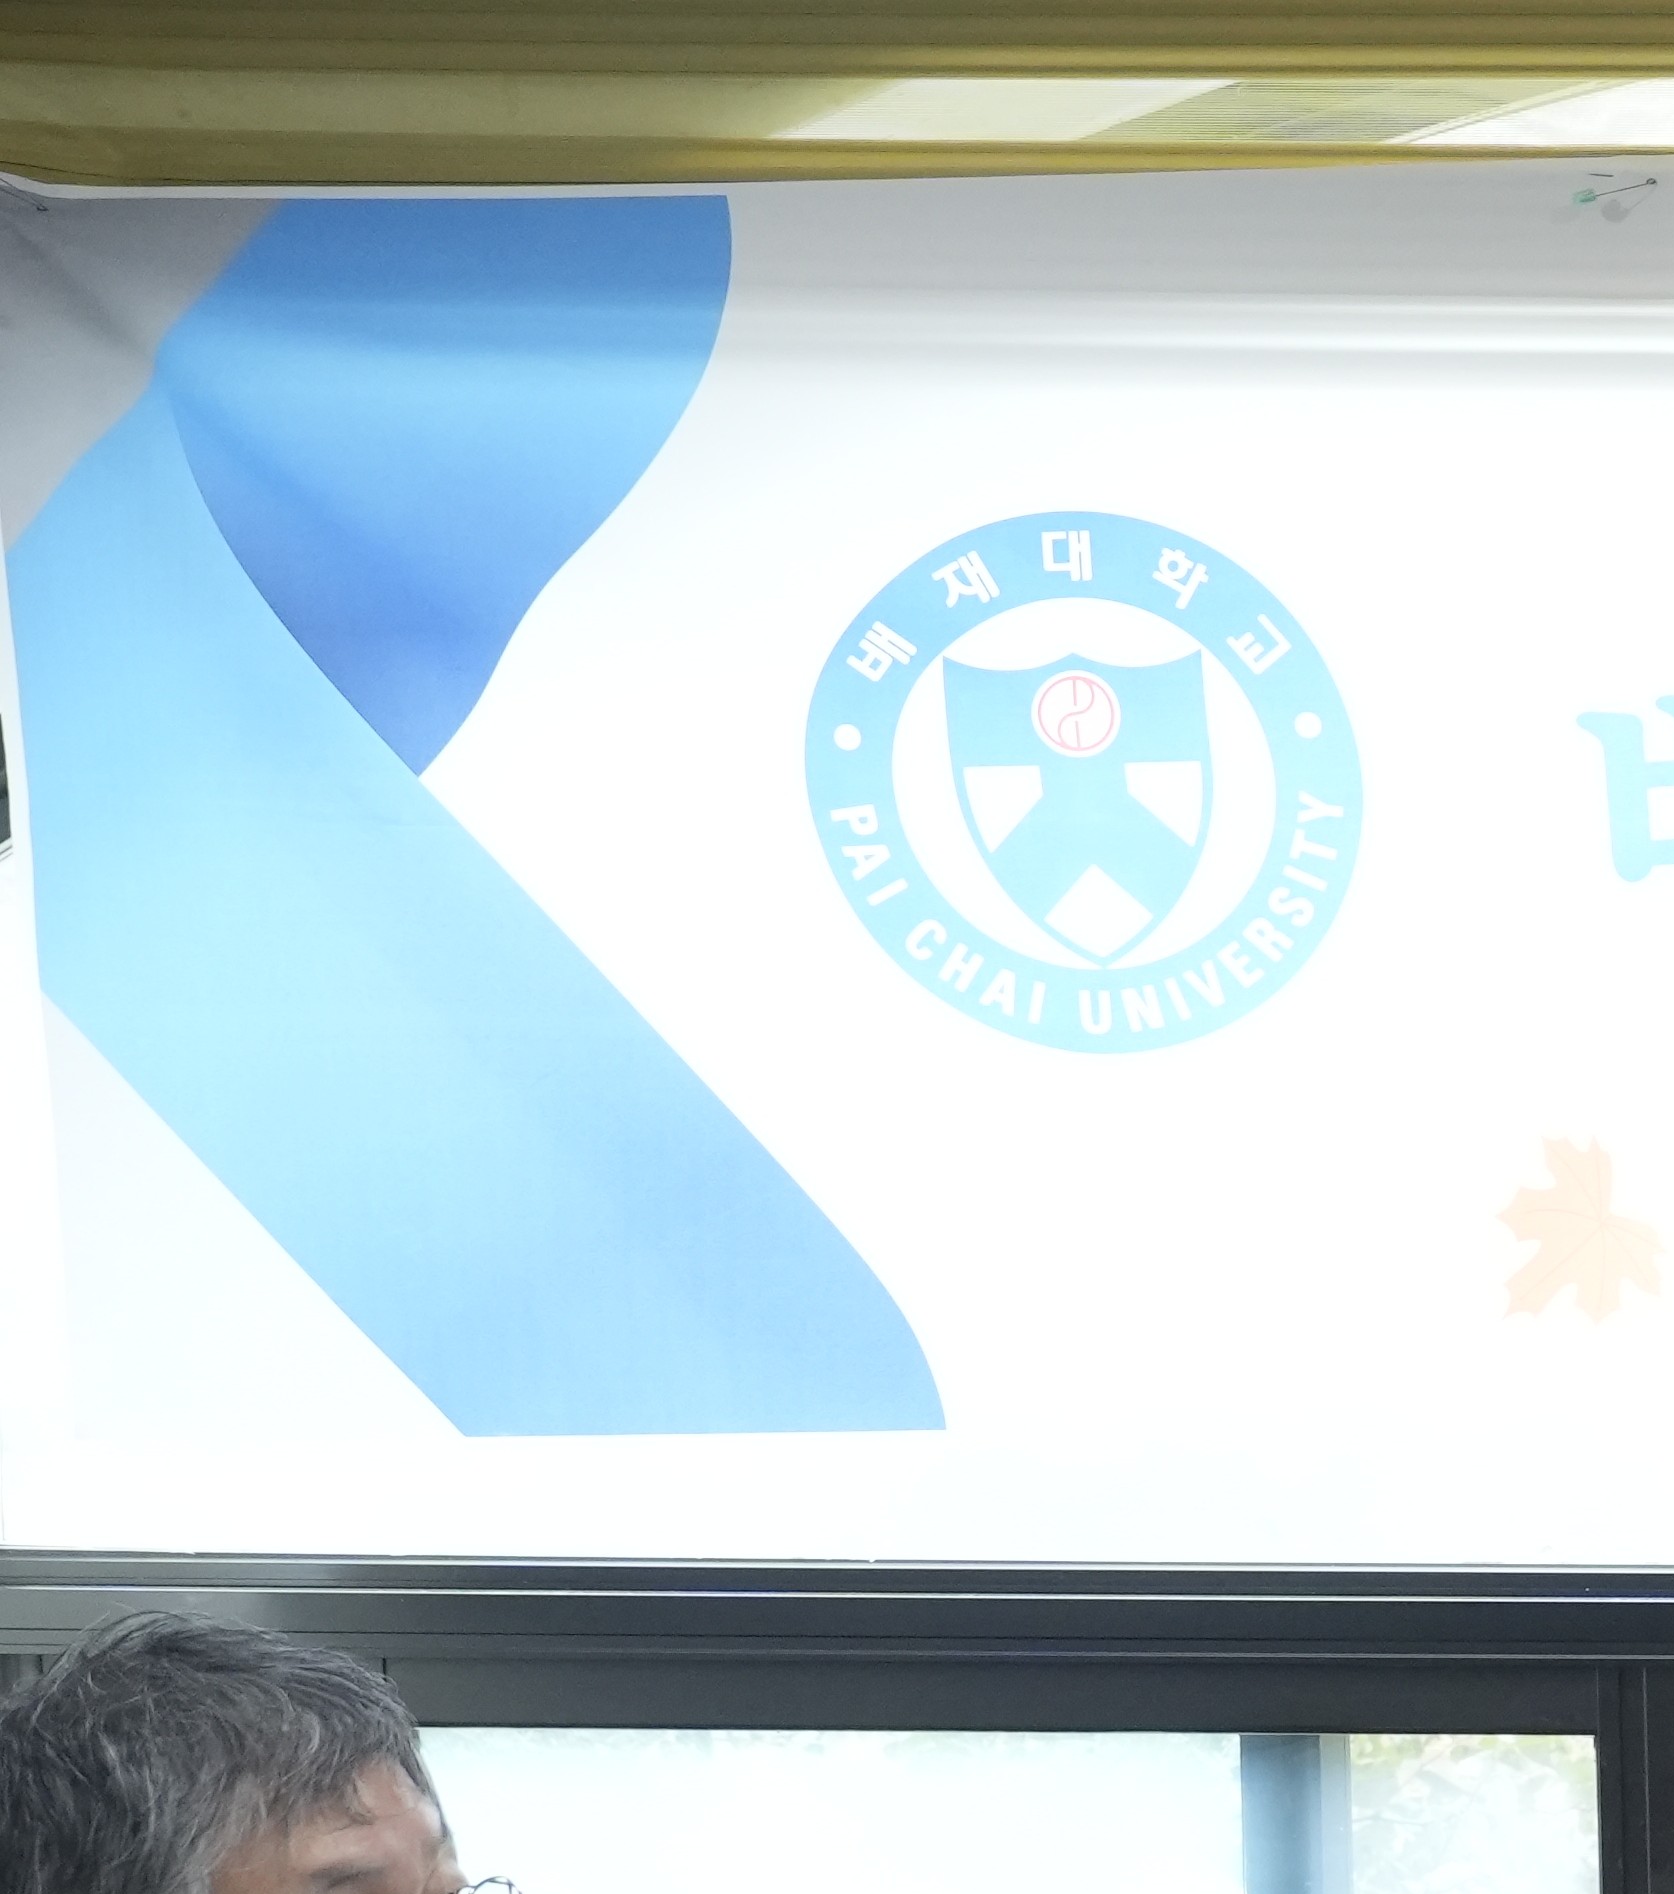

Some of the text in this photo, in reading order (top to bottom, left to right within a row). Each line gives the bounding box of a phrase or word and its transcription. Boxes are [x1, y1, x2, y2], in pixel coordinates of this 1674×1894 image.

[829, 790, 1345, 1035] PAI CHAI UNIVERSITY
